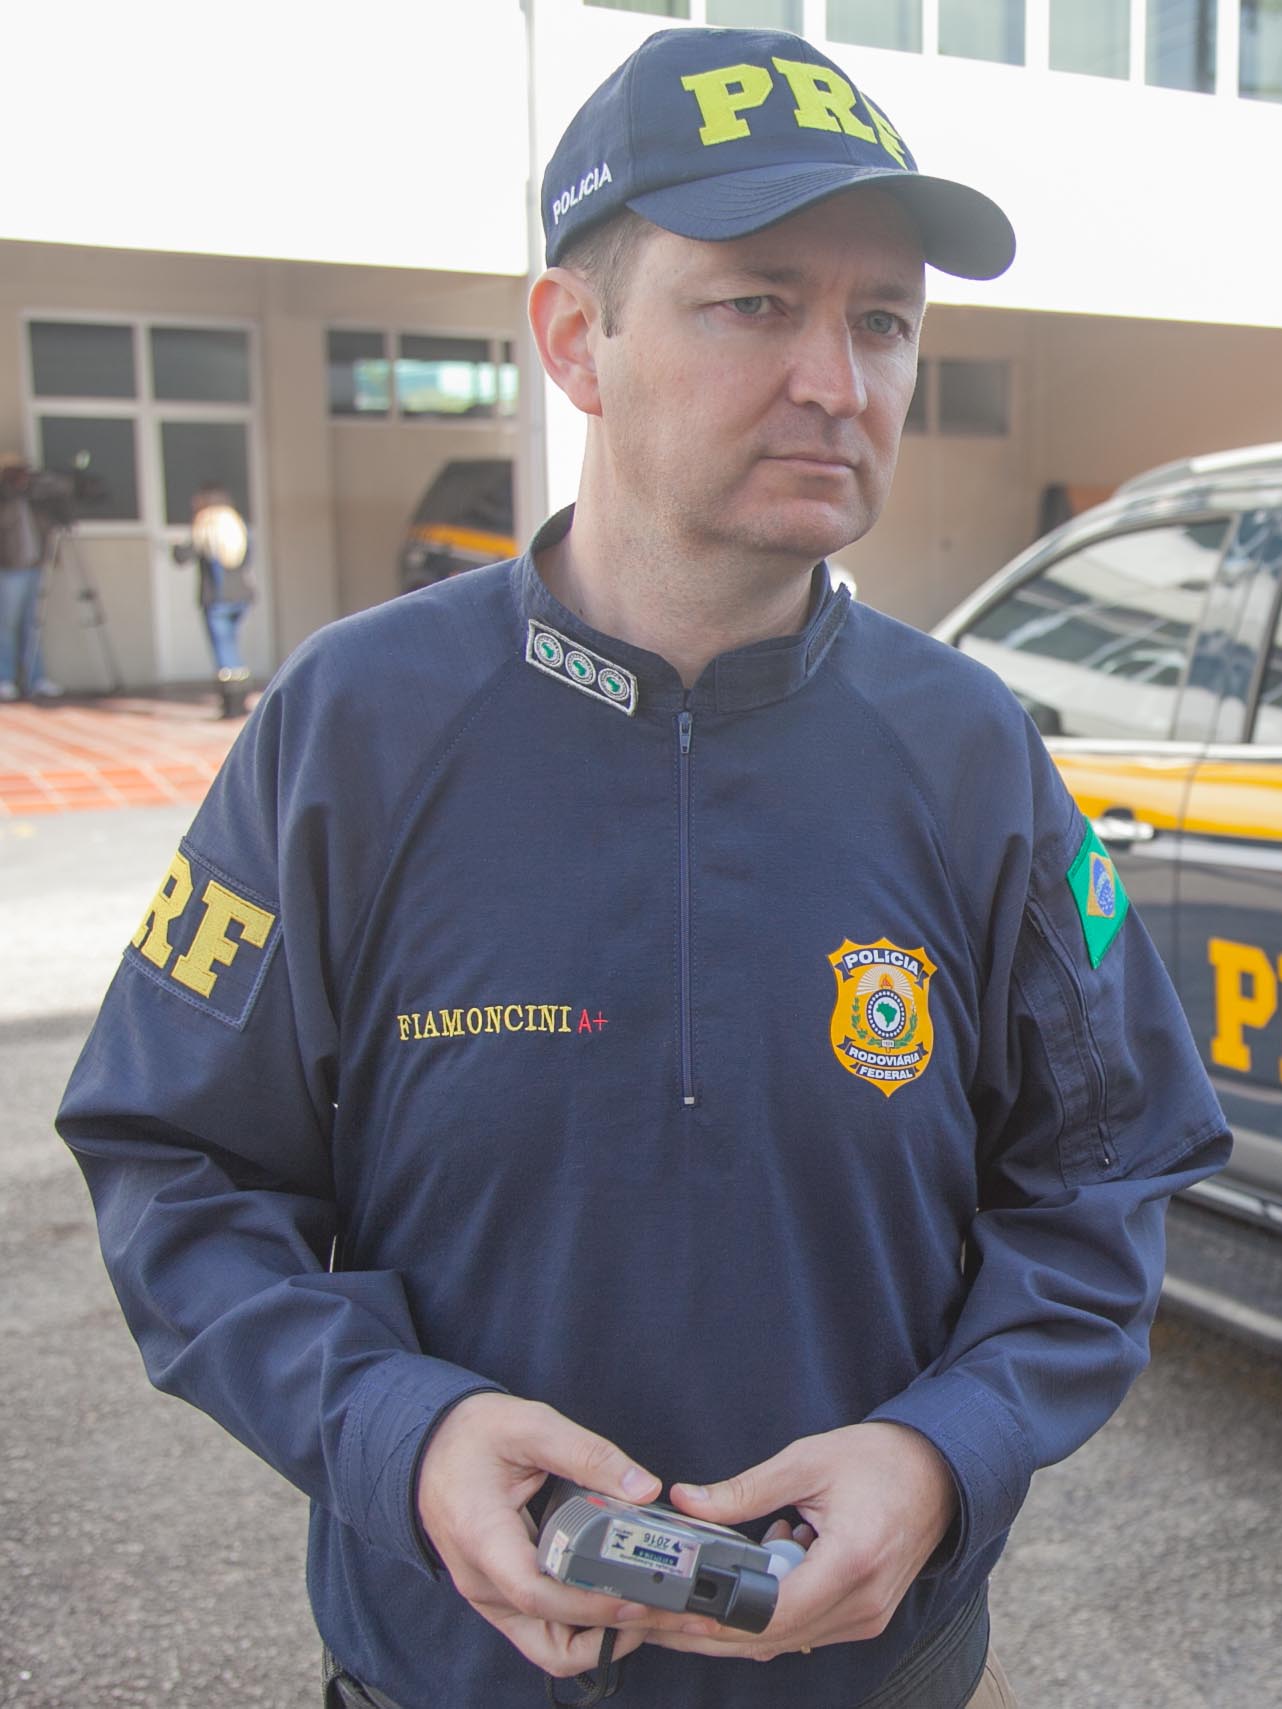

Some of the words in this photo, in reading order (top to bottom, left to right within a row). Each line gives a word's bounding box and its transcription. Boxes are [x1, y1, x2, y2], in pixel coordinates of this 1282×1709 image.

[844, 949, 919, 975] POLÍCIA
[396, 1004, 572, 1041] FIAMONCINI
[577, 1008, 609, 1034] A+
[849, 1047, 920, 1066] RODOVIÁRIA
[859, 1067, 913, 1080] FEDERAL
[643, 1532, 671, 1548] 2016
